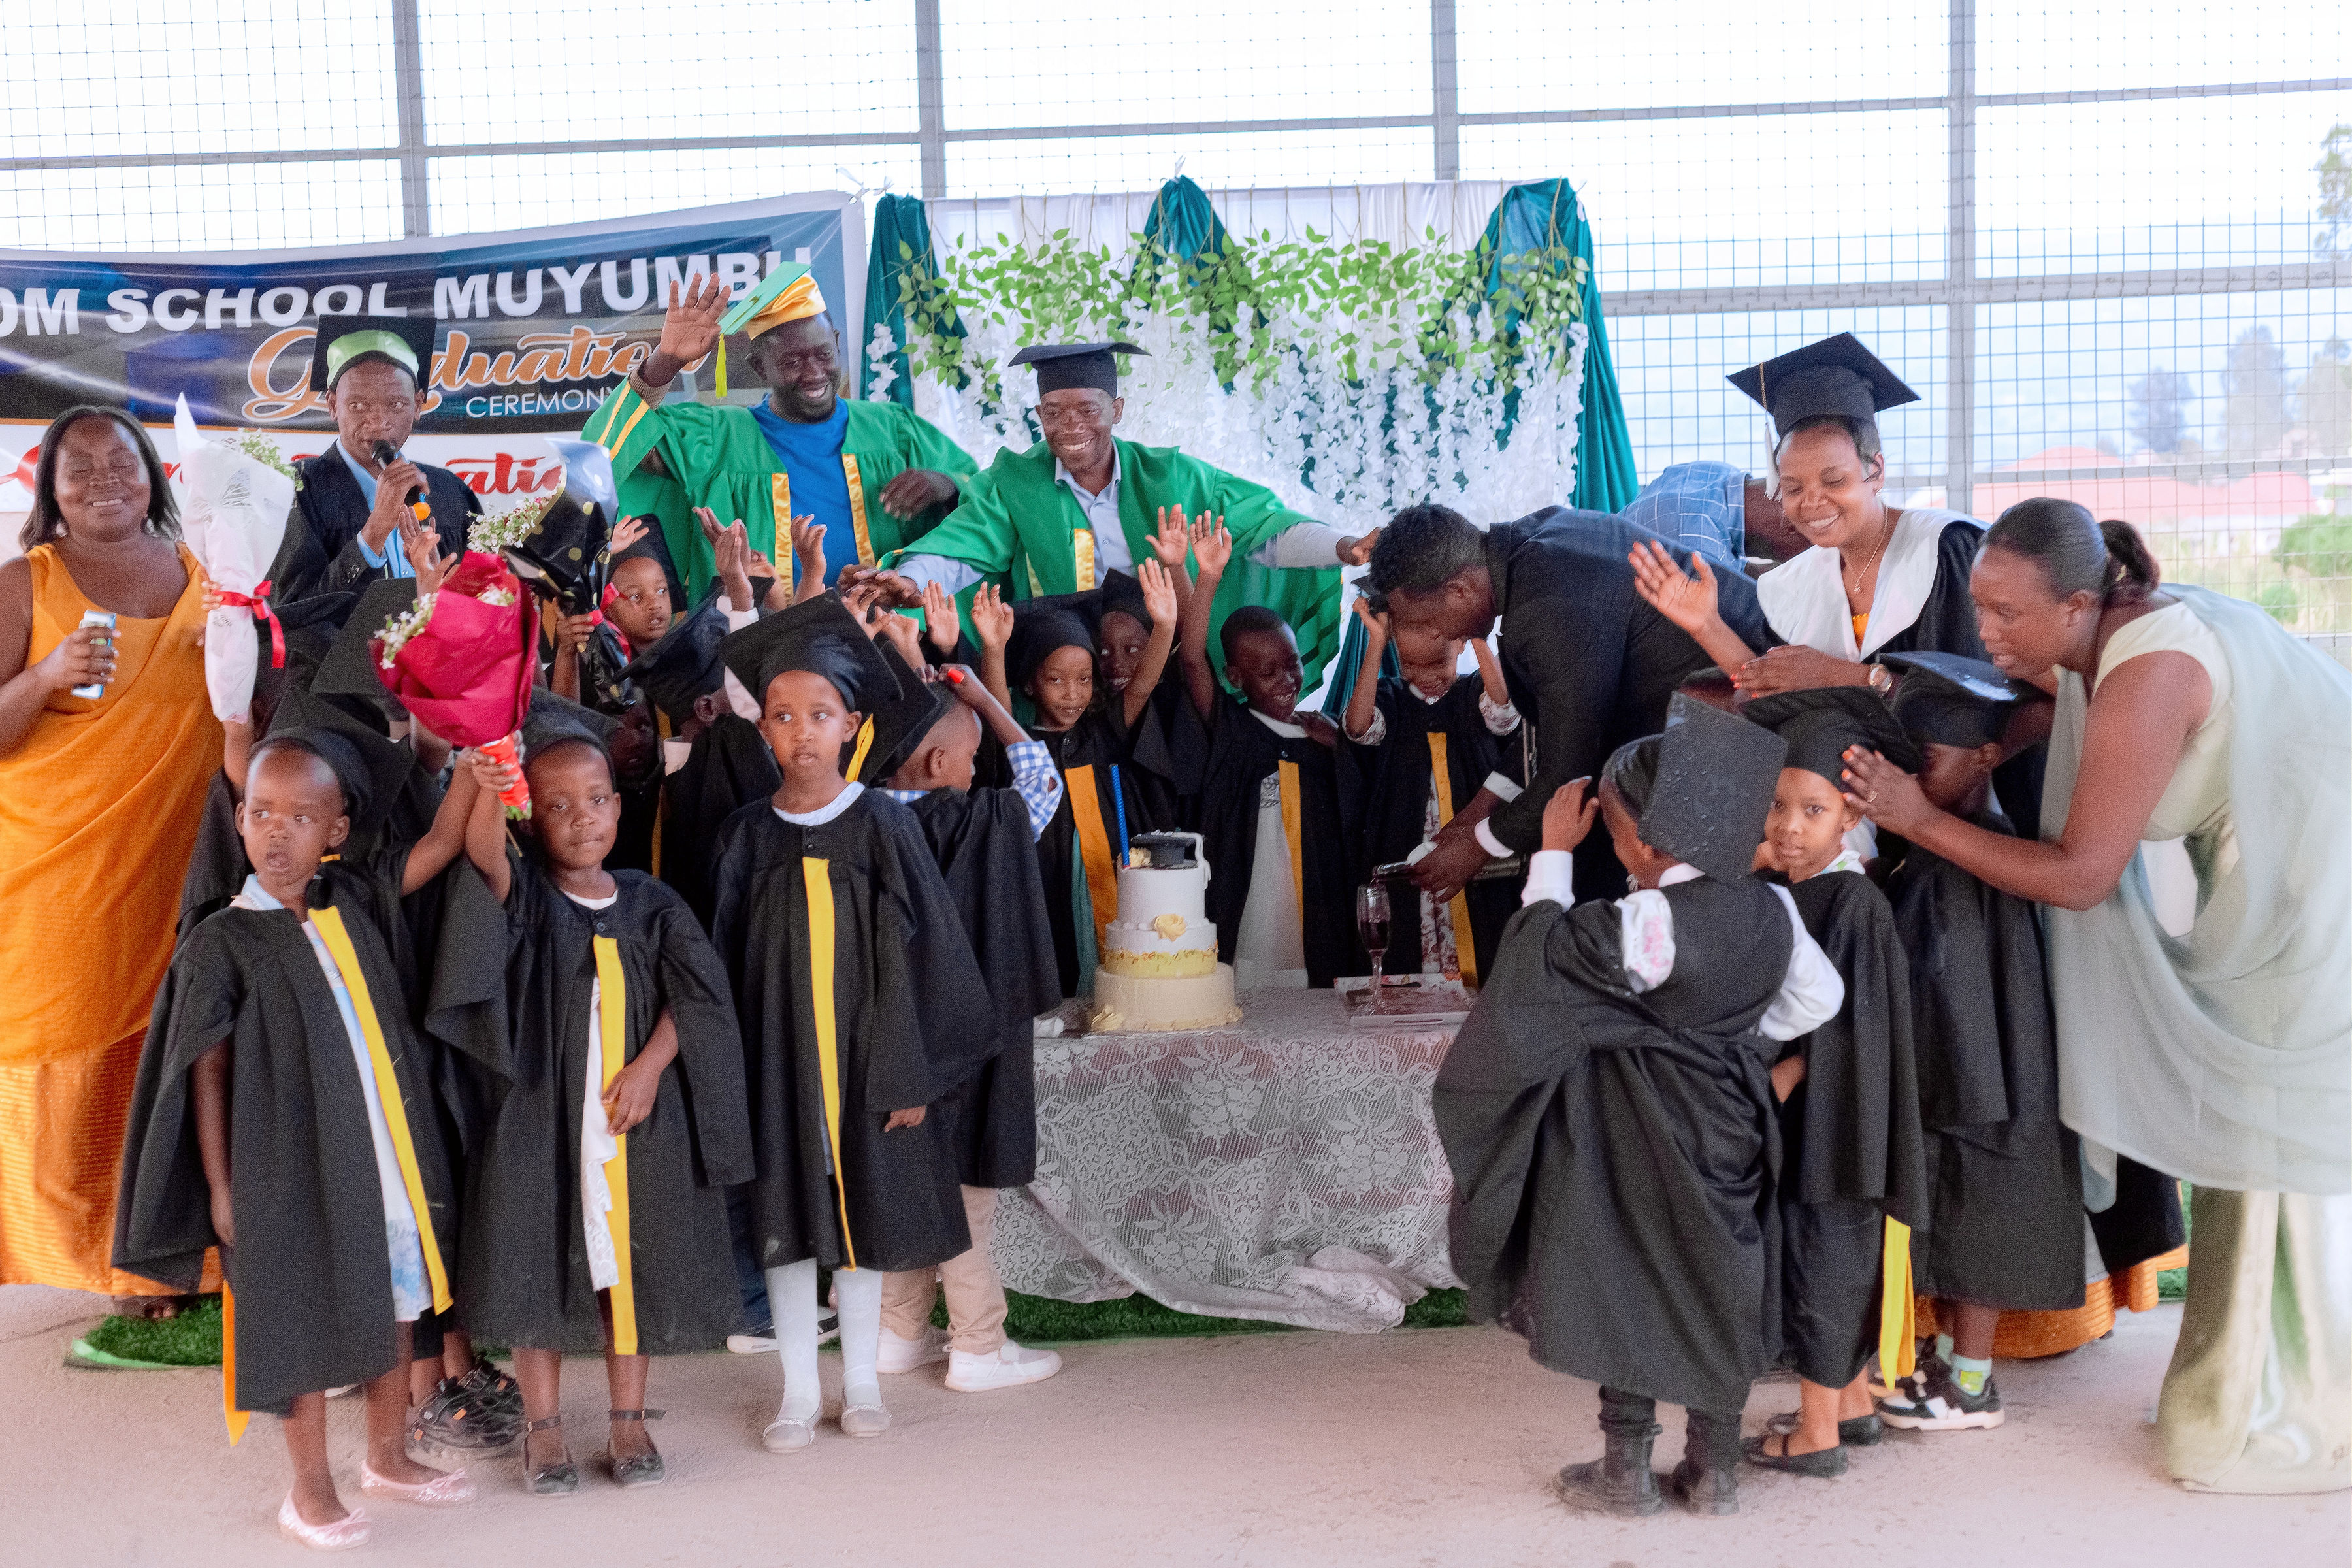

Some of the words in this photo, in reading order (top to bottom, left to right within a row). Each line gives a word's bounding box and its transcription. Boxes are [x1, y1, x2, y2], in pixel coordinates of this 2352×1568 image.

[105, 282, 408, 334] SCHOOL
[242, 325, 712, 422] Gduatio
[466, 386, 613, 418] CEREMON
